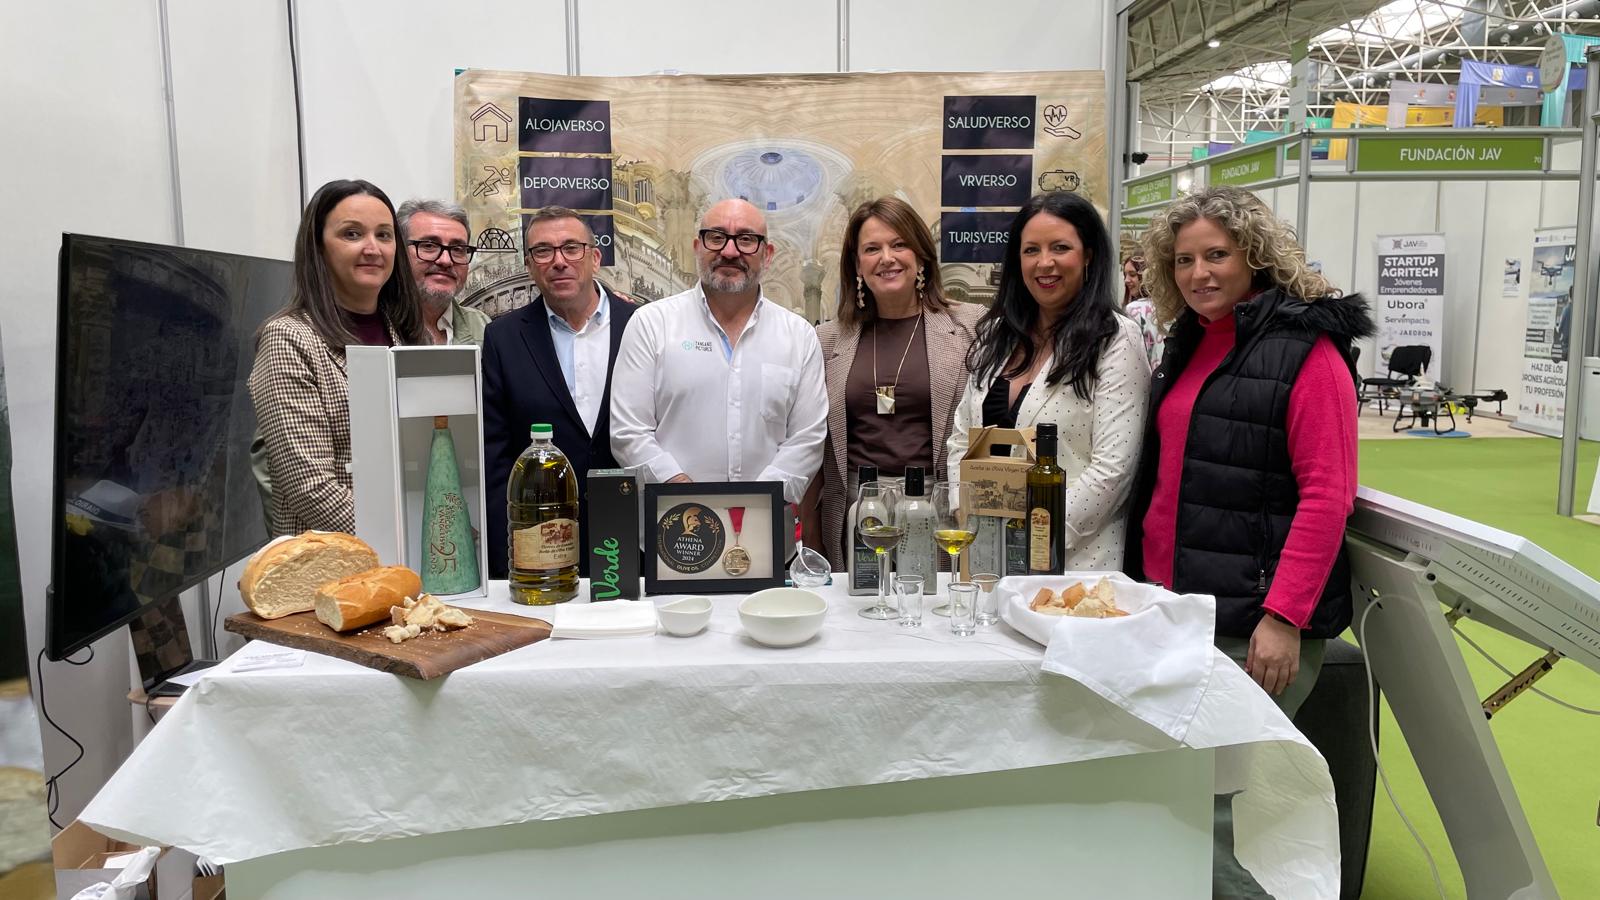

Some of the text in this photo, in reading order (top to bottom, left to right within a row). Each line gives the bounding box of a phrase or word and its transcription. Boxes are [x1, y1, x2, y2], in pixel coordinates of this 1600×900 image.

[525, 117, 605, 133] ALOJAVERSO
[948, 115, 1031, 130] SALUDVERSO
[1400, 145, 1502, 161] FUNDACIÓN JAV
[523, 176, 610, 191] DEPORVERSO
[959, 174, 1017, 188] VRVERSO
[1064, 175, 1075, 183] VR
[948, 230, 1009, 245] TURISVERS
[1403, 240, 1418, 248] JAV
[1384, 256, 1436, 267] STARTUP
[1381, 267, 1439, 278] AGRITECH
[1394, 278, 1422, 286] Jóvenes
[1380, 286, 1437, 295] Emprendedores
[1531, 362, 1564, 374] HAZ DE LOS
[1525, 385, 1565, 399] TU PROFESIÓN
[677, 536, 703, 544] ATHENA
[673, 542, 705, 551] AWARD
[430, 541, 456, 574] 25
[855, 551, 880, 562] Verd
[591, 537, 622, 601] Verde
[676, 564, 691, 572] OLIVE
